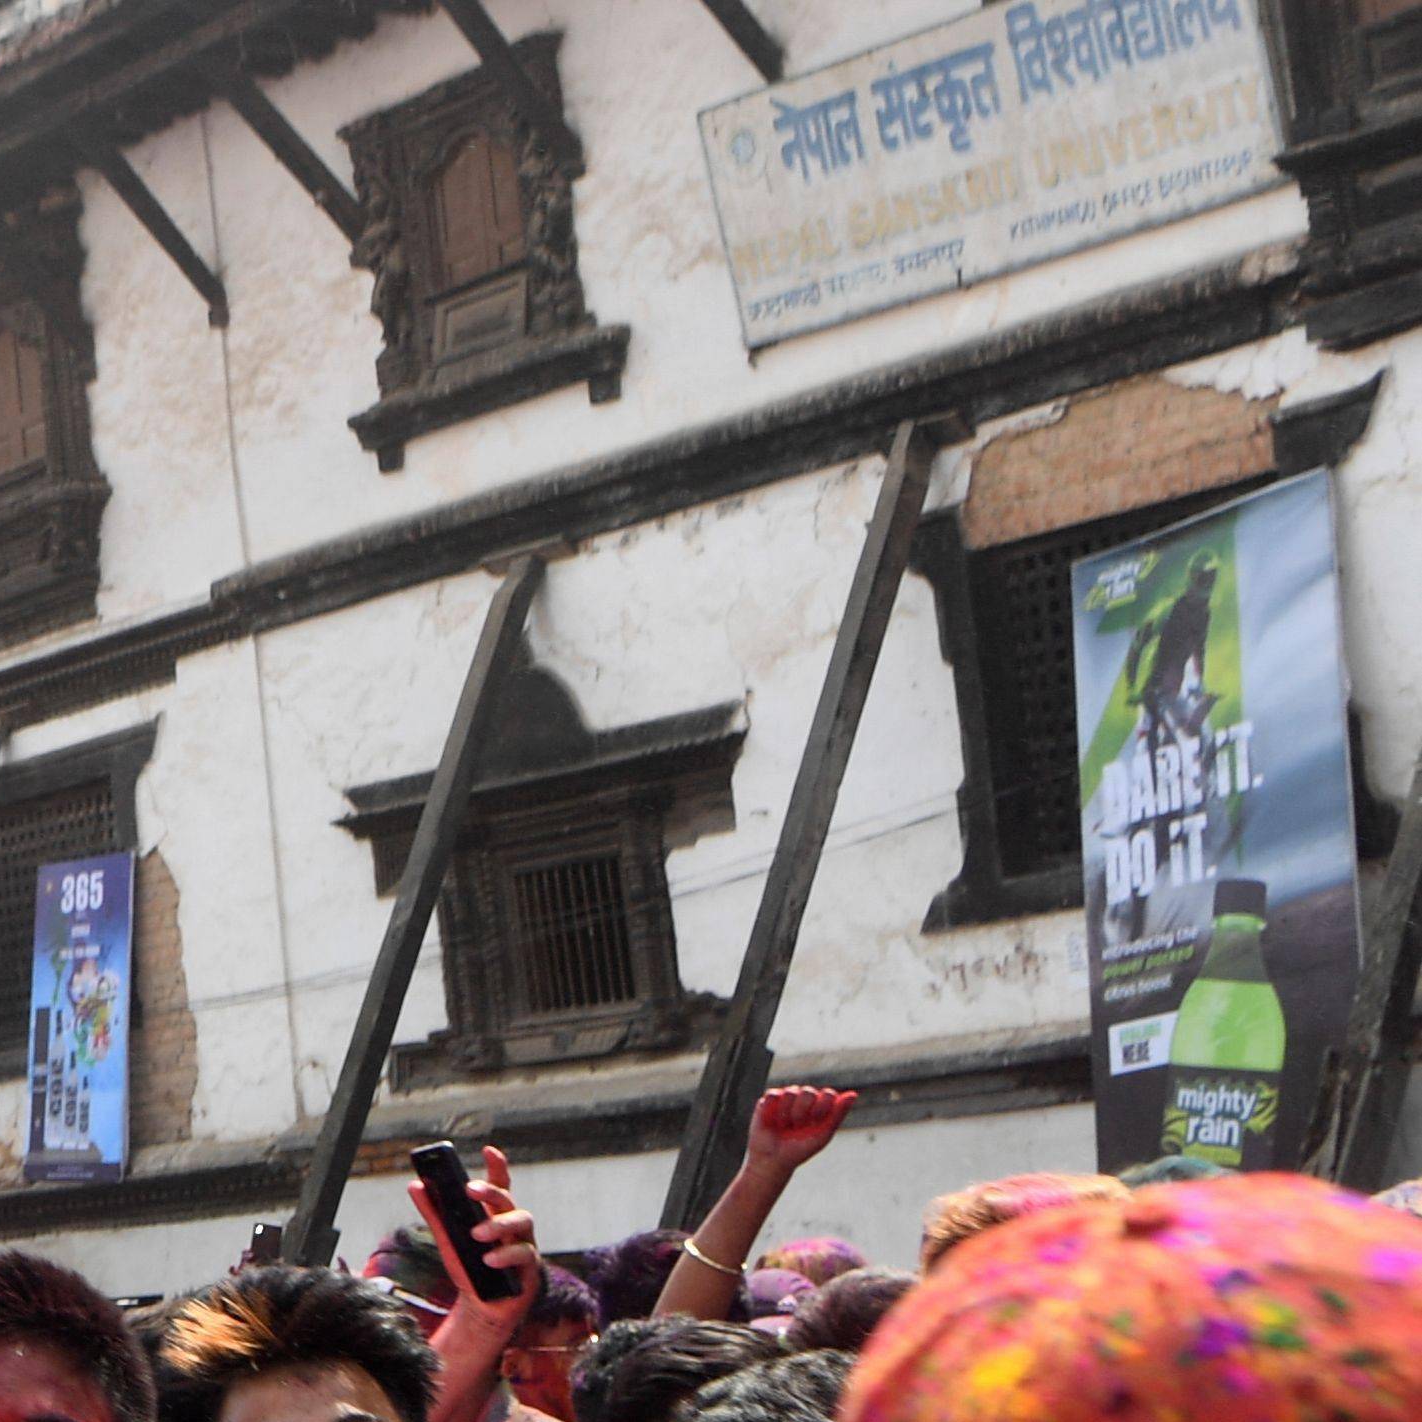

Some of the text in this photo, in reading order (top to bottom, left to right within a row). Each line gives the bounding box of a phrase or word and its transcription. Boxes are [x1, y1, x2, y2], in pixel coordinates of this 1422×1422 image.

[770, 97, 864, 184] नेपाल
[870, 41, 1001, 152] संस्कृत
[733, 214, 841, 288] NEPAL
[848, 154, 1018, 250] SANSKRIT
[1033, 77, 1261, 189] UNIVERSITY
[1101, 733, 1204, 834] DARE
[60, 871, 105, 914] 365
[1106, 830, 1157, 905] DO
[1177, 1083, 1257, 1120] mighty
[1185, 1115, 1240, 1147] rain
